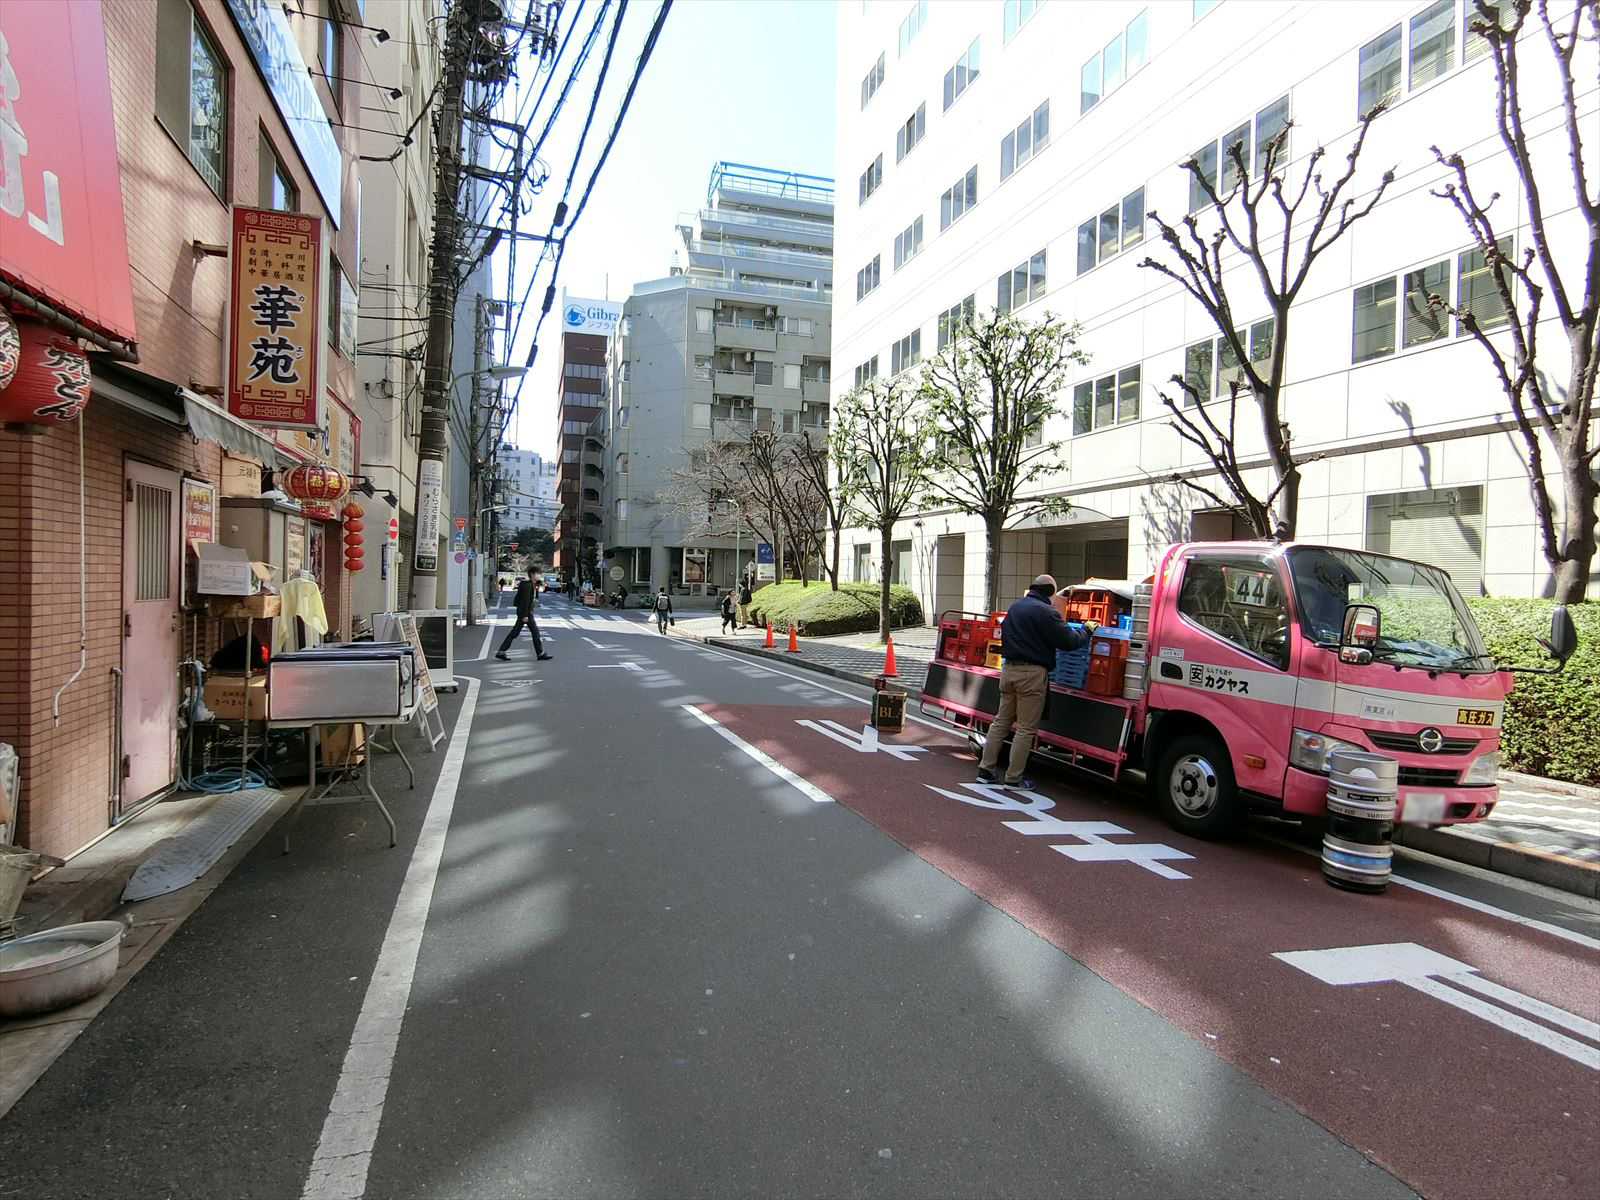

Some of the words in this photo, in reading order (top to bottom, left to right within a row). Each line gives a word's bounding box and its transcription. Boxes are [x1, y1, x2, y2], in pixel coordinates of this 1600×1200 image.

[249, 247, 306, 262] 台湾・四川
[248, 267, 305, 282] 中華居酒屋
[248, 285, 301, 384] 華苑
[1236, 576, 1264, 604] 44
[1204, 675, 1249, 694] カクヤス
[1458, 709, 1494, 725] 高圧ガス
